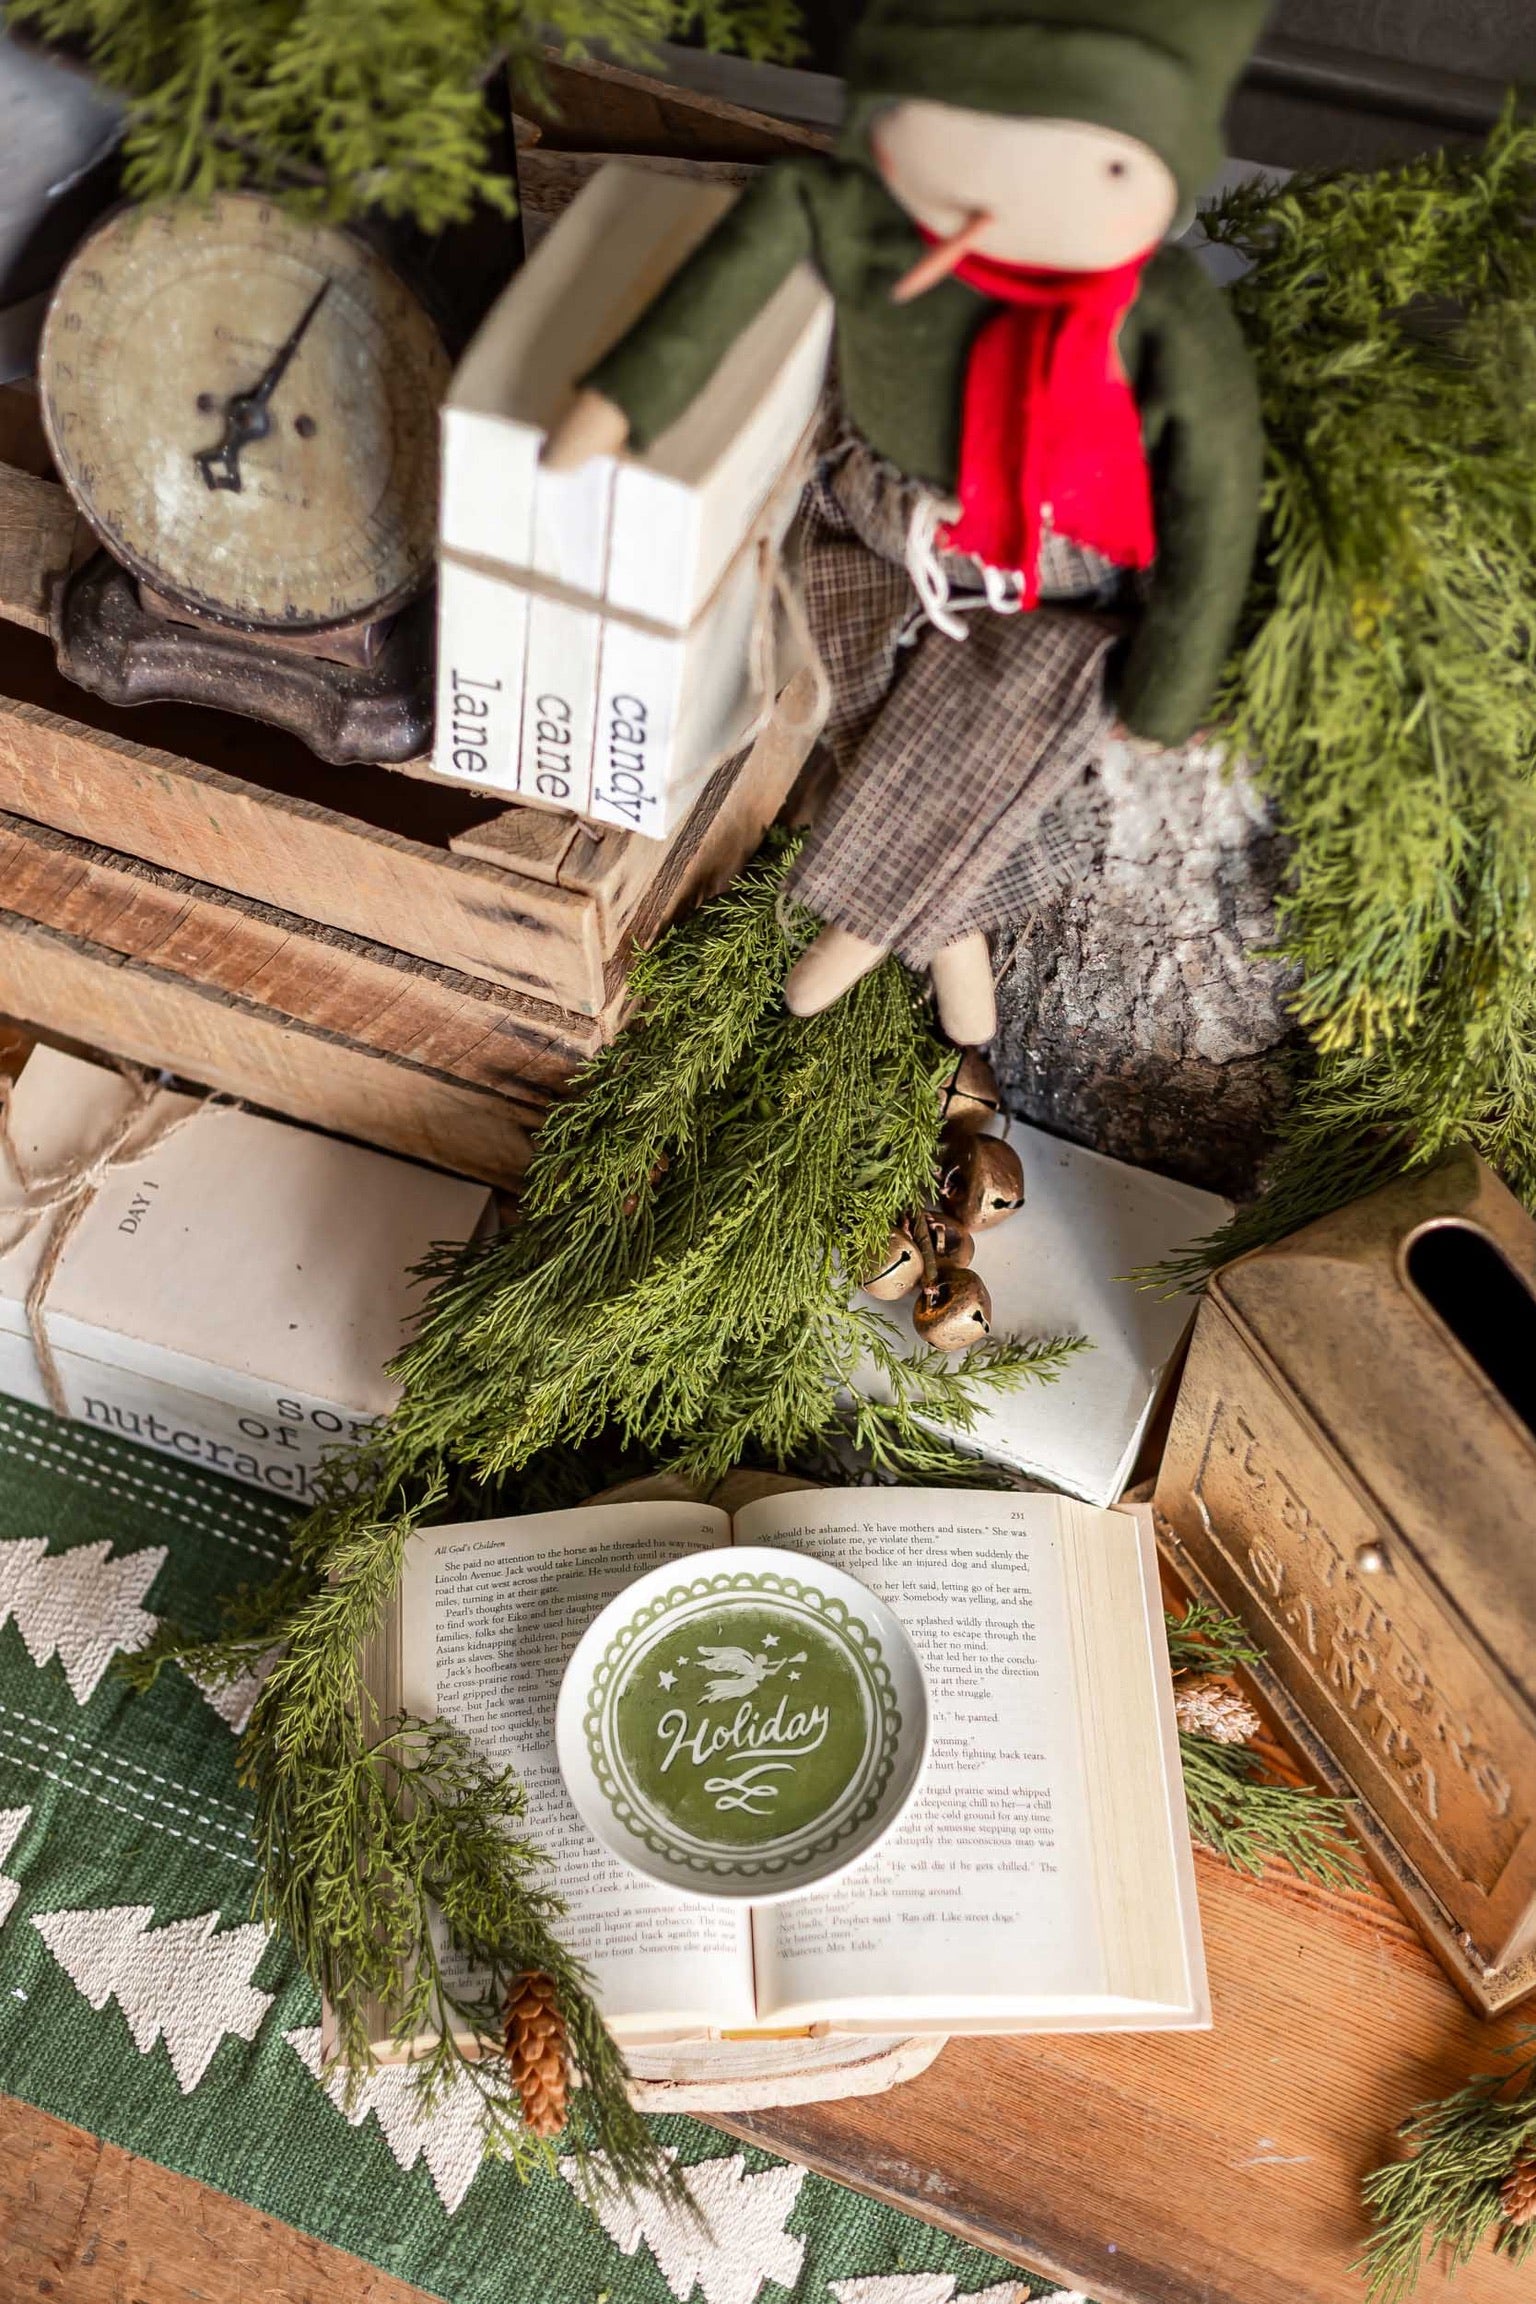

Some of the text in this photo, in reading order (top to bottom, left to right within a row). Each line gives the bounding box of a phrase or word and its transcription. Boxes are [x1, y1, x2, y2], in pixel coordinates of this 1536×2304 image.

[451, 669, 503, 773] lane
[536, 693, 572, 798] cane
[595, 694, 657, 823] candy
[118, 1192, 150, 1234] DAY
[238, 1417, 301, 1451] of
[82, 1396, 324, 1503] nutcrack
[774, 1527, 802, 1541] should
[805, 1526, 816, 1535] be
[819, 1524, 860, 1533] ashamed.
[863, 1524, 874, 1532] Ye
[876, 1523, 897, 1532] have
[900, 1523, 935, 1532] mothers
[938, 1525, 953, 1533] and
[992, 1527, 1008, 1536] She
[473, 1541, 505, 1550] Children
[805, 1535, 909, 1548] ye violate violate
[445, 1562, 460, 1571] She
[463, 1560, 481, 1571] paid
[497, 1553, 535, 1565] attention
[548, 1549, 561, 1558] the
[563, 1546, 588, 1556] horse
[600, 1542, 610, 1551] he
[613, 1539, 650, 1550] threaded
[849, 1546, 1029, 1560] the bodice her dress when suddenly the
[435, 1573, 467, 1584] Lincoln
[505, 1567, 524, 1577] Jack
[527, 1562, 553, 1573] would
[555, 1559, 574, 1569] take
[575, 1555, 608, 1565] Lincoln
[611, 1551, 635, 1561] north
[849, 1558, 1030, 1573] yelped like injured dog and slumped,
[435, 1563, 631, 1595] road that cut west across the He would
[885, 1580, 1032, 1595] her left said, letting her arm.
[435, 1587, 539, 1608] miles, turning their
[903, 1593, 1033, 1606] Somebody was yelling, and she
[446, 1595, 565, 1618] Pearl's thoughts were the
[447, 1607, 562, 1629] find work and her
[916, 1616, 1035, 1630] splashed wildly through the
[436, 1622, 540, 1643] families, folks she knew
[911, 1629, 1036, 1641] trying escape through the
[436, 1634, 558, 1654] Asians kidnapping children,
[933, 1640, 988, 1650] her mind.
[436, 1646, 540, 1668] girls She shook
[927, 1651, 1004, 1664] that led her the
[446, 1661, 517, 1679] Jack's hoofbeats
[924, 1663, 1040, 1677] She turned the direction
[1248, 1535, 1438, 1820] SANTA
[437, 1676, 508, 1690] the cross-prairie
[437, 1685, 514, 1702] Pearl gripped the
[941, 1688, 955, 1697] the
[467, 1698, 504, 1711] but Jack
[462, 1704, 551, 1722] Then the
[469, 1725, 488, 1735] road
[474, 1729, 550, 1746] Pearl thought she
[657, 1695, 829, 1772] Holiday
[1000, 1750, 1020, 1759] back
[935, 1760, 954, 1770] hurt
[955, 1786, 984, 1799] prairie
[987, 1786, 1009, 1795] wind
[1012, 1786, 1050, 1799] whipped
[547, 1801, 562, 1811] had
[568, 1824, 585, 1833] She
[550, 1837, 584, 1848] walking
[583, 1848, 600, 1858] hast
[564, 1861, 589, 1872] down
[560, 1874, 590, 1886] turned
